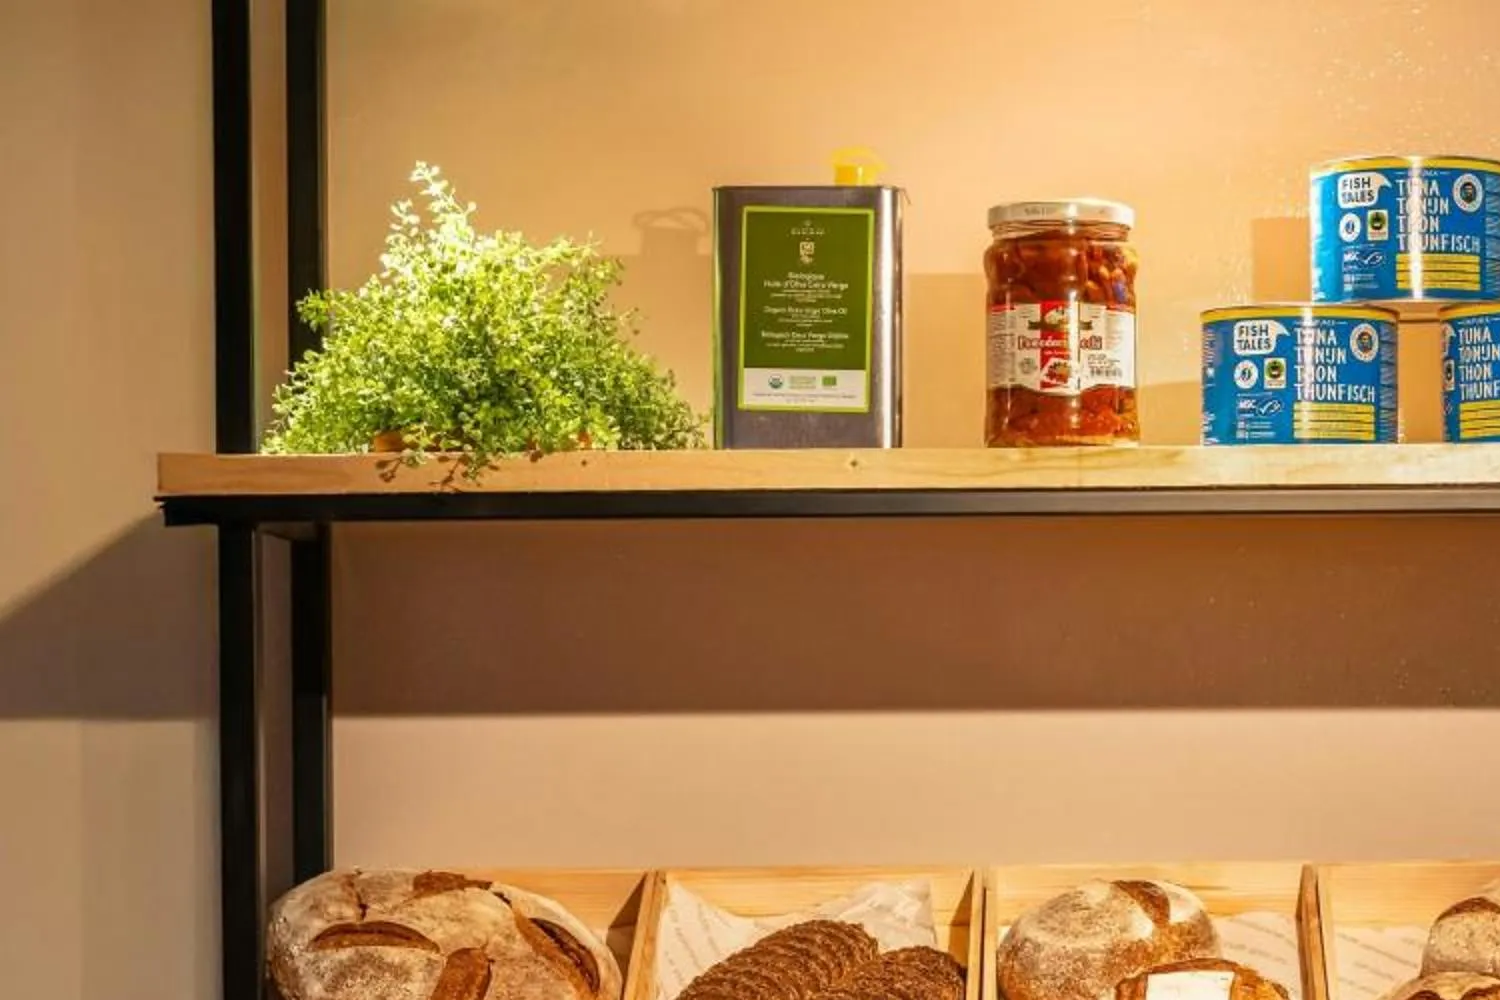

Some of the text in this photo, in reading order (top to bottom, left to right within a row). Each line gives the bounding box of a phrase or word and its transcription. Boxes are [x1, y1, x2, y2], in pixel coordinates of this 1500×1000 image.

[1342, 177, 1371, 188] FISH
[1396, 179, 1440, 197] TNA
[1341, 190, 1374, 203] TALES
[1396, 197, 1450, 215] TNIJN
[1396, 215, 1440, 233] TON
[1396, 234, 1481, 253] TUNFISCH
[1238, 324, 1269, 337] FISH
[1458, 326, 1493, 345] TUNA
[1236, 337, 1271, 351] TALES
[1458, 365, 1493, 382] THON
[1294, 383, 1375, 402] THUNFISCH
